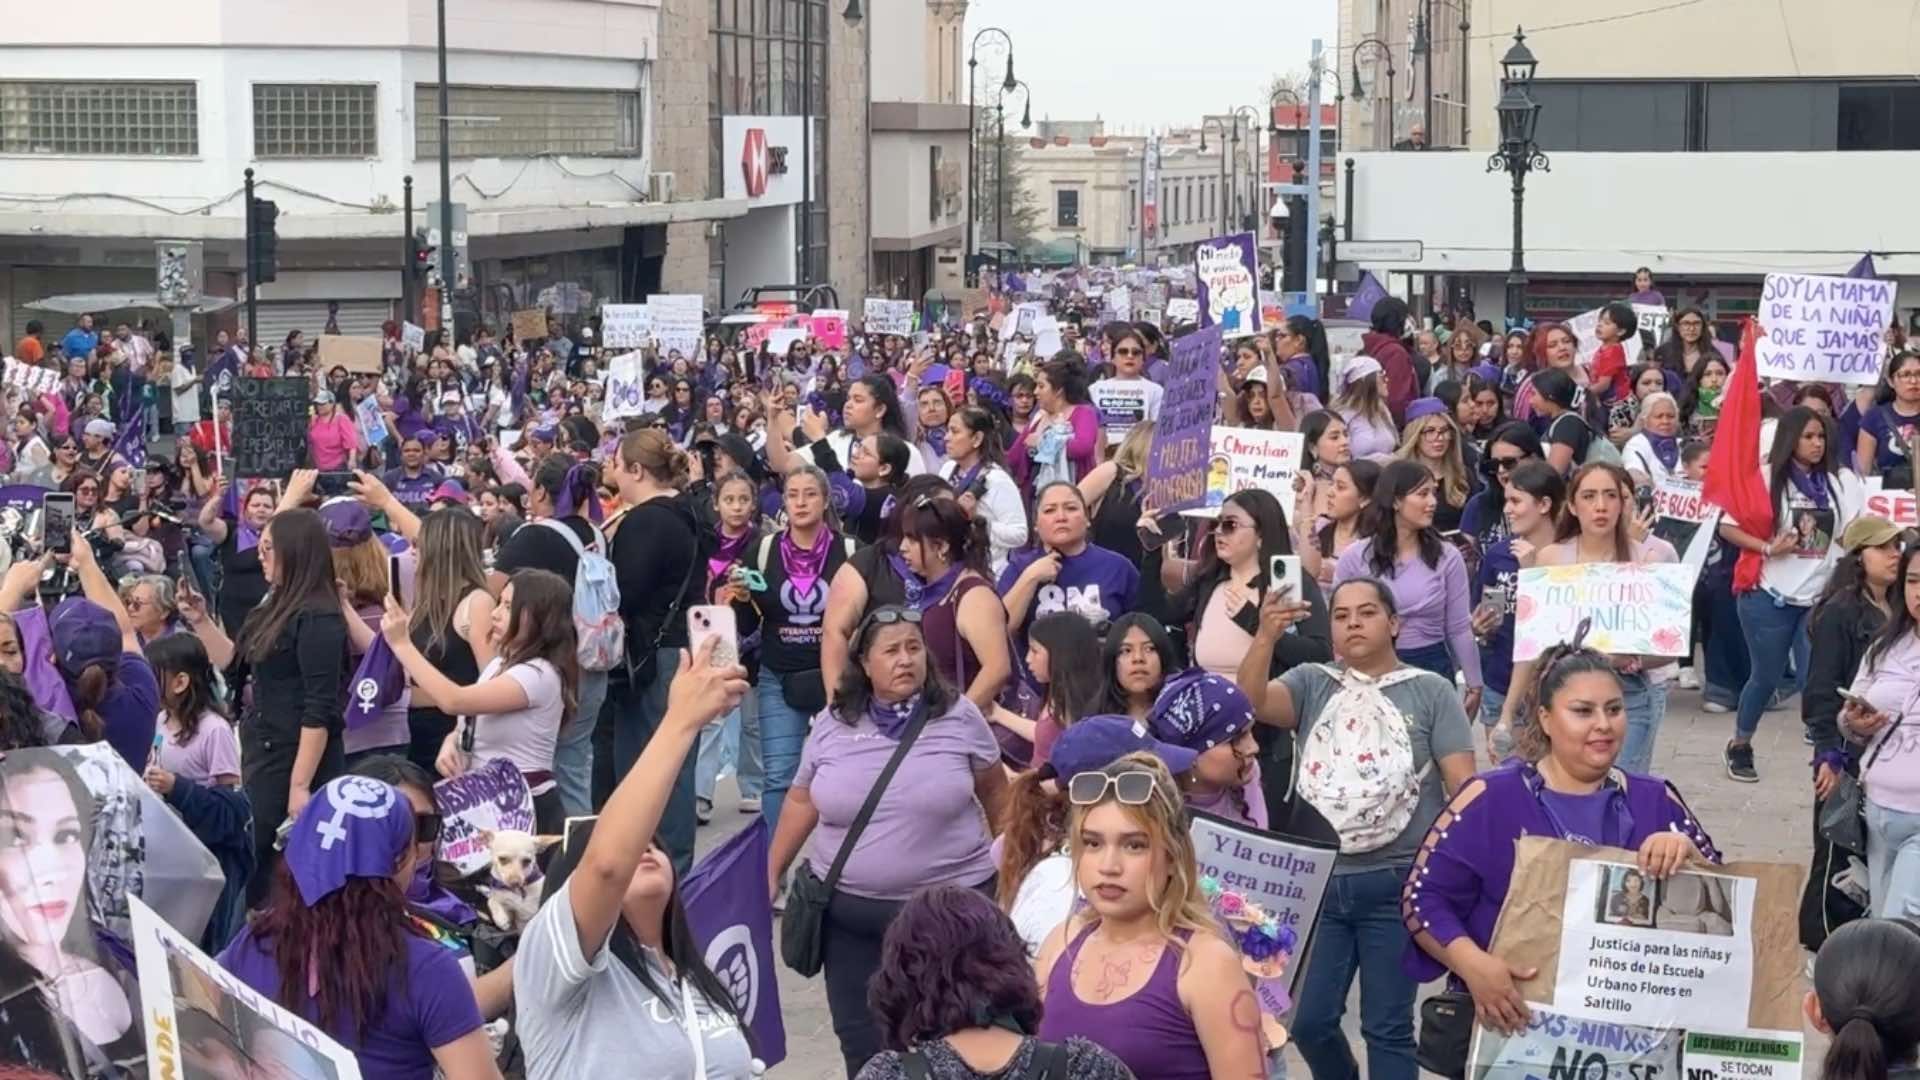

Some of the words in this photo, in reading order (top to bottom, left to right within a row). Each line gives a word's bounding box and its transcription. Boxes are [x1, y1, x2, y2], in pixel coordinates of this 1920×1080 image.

[1210, 273, 1248, 289] FUERZA
[1764, 274, 1805, 301] SOY
[1805, 279, 1826, 302] LA
[1771, 303, 1793, 319] DE
[1802, 306, 1821, 323] LA
[1830, 303, 1882, 328] NIÑA
[1772, 327, 1806, 347] QUE
[1817, 328, 1879, 352] JAMÁS
[1763, 352, 1795, 370] VAS
[1803, 353, 1815, 370] A
[1822, 353, 1880, 374] TOCAR
[1159, 438, 1198, 471] MUJER
[1223, 434, 1289, 458] Christian
[1252, 464, 1293, 479] Mami
[1150, 467, 1204, 509] PODEROSA
[1653, 489, 1667, 513] SE
[1868, 495, 1916, 523] SE
[1036, 583, 1100, 620] 8M
[1555, 603, 1651, 635] JUNTAS
[1232, 840, 1253, 861] la
[1258, 852, 1316, 876] culpa
[1223, 870, 1257, 890] era
[1589, 935, 1641, 953] Justicia
[1644, 944, 1670, 957] para
[1672, 944, 1689, 957] las
[1691, 946, 1723, 961] niñas
[1724, 951, 1732, 965] y
[1589, 956, 1627, 971] niños
[1630, 960, 1646, 973] de
[1648, 962, 1660, 975] la
[1663, 964, 1705, 979] Escuela
[1587, 975, 1637, 993] Urbano
[1640, 980, 1676, 997] Flores
[1678, 986, 1692, 998] en
[1584, 995, 1632, 1012] Saltillo
[1710, 1037, 1736, 1052] NIÑOS
[1736, 1040, 1743, 1052] Y
[1744, 1041, 1759, 1054] LAS
[1761, 1042, 1789, 1056] NIÑAS
[1548, 1046, 1608, 1080] NO
[1720, 1061, 1735, 1073] SE
[1735, 1062, 1773, 1077] TOCAN
